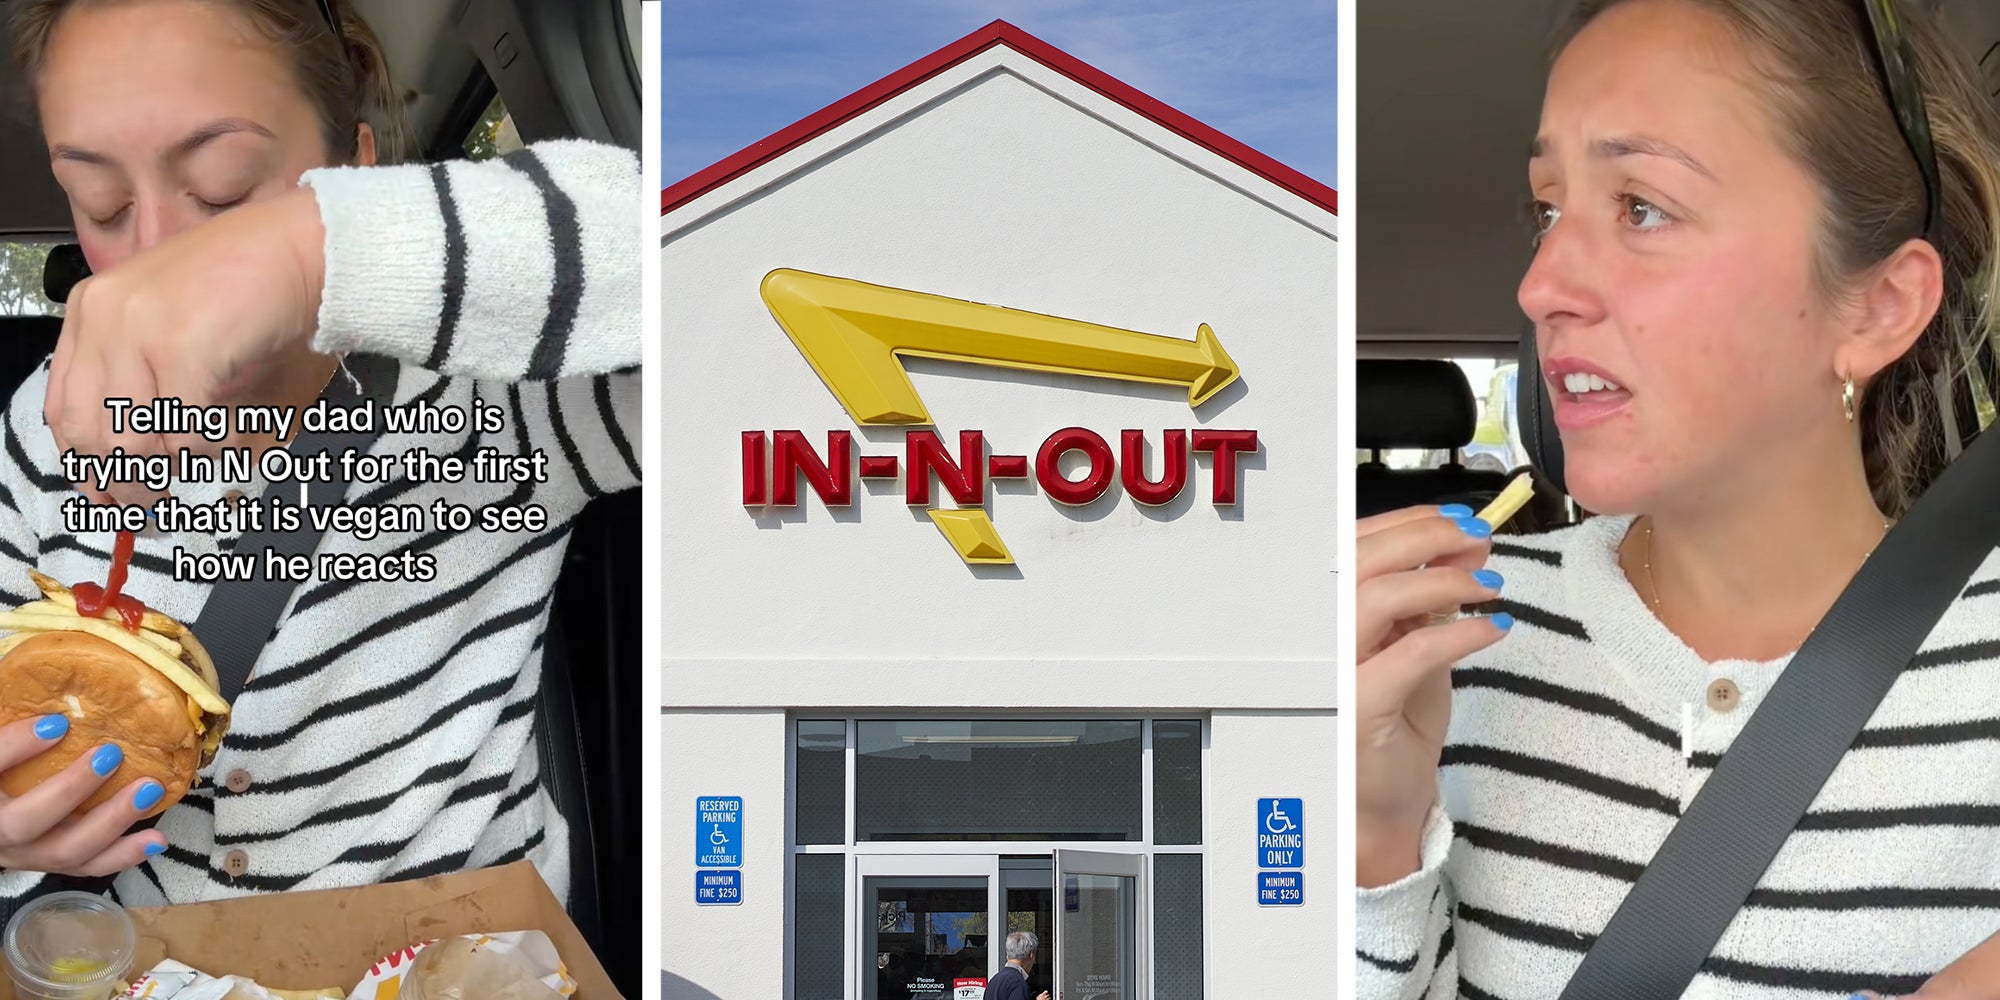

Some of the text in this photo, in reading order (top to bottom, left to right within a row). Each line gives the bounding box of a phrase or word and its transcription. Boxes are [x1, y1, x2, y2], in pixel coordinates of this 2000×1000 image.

[741, 426, 1259, 507] IN-N-OUT
[699, 800, 739, 811] RESERVED
[702, 812, 736, 823] PARKING
[1259, 834, 1301, 848] PARKING
[712, 846, 726, 854] VAN
[701, 855, 737, 864] ACCESSIBLE
[1267, 850, 1294, 865] ONLY
[703, 876, 734, 885] MINIMUM
[1265, 877, 1295, 887] MINIMUM
[699, 887, 738, 898] FINE $250
[1261, 888, 1300, 900] FINE $250
